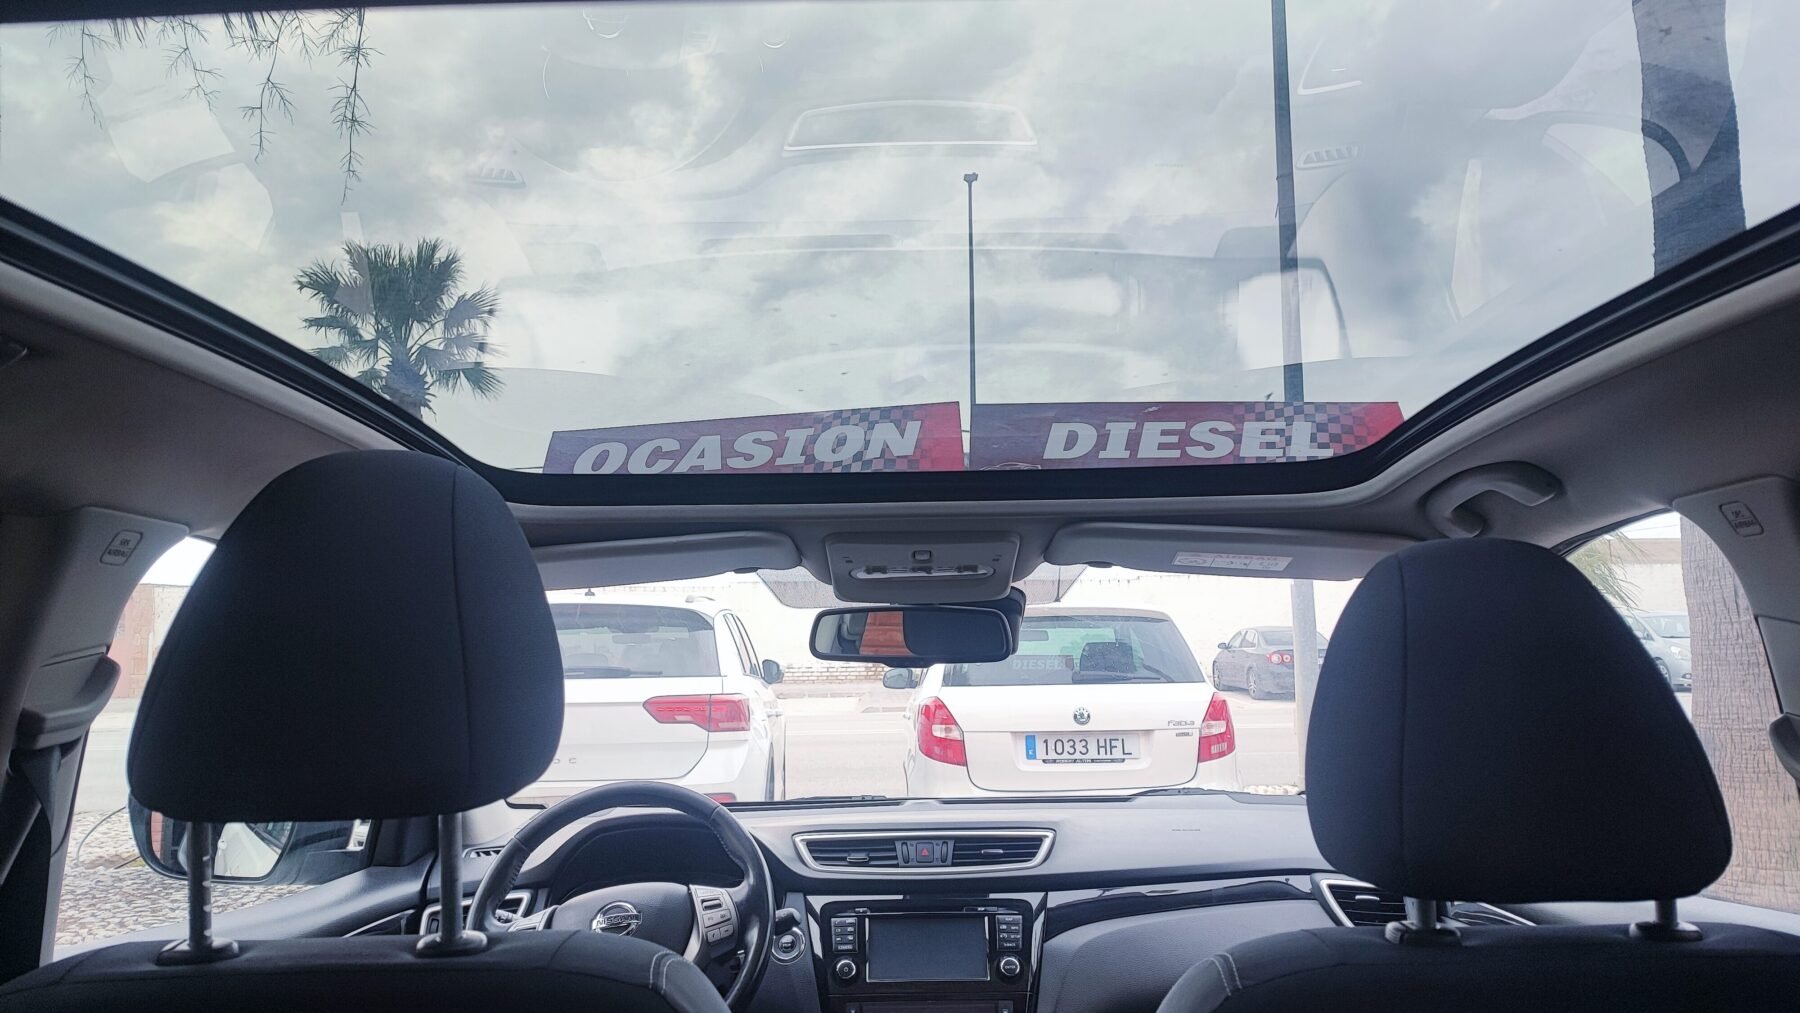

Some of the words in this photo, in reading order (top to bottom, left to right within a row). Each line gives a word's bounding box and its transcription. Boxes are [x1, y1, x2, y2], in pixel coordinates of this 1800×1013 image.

[573, 421, 923, 474] OCASION
[1043, 421, 1334, 460] DIESEL
[1012, 659, 1063, 670] DIESEL
[1043, 738, 1089, 756] 1033
[1096, 738, 1133, 756] HFL
